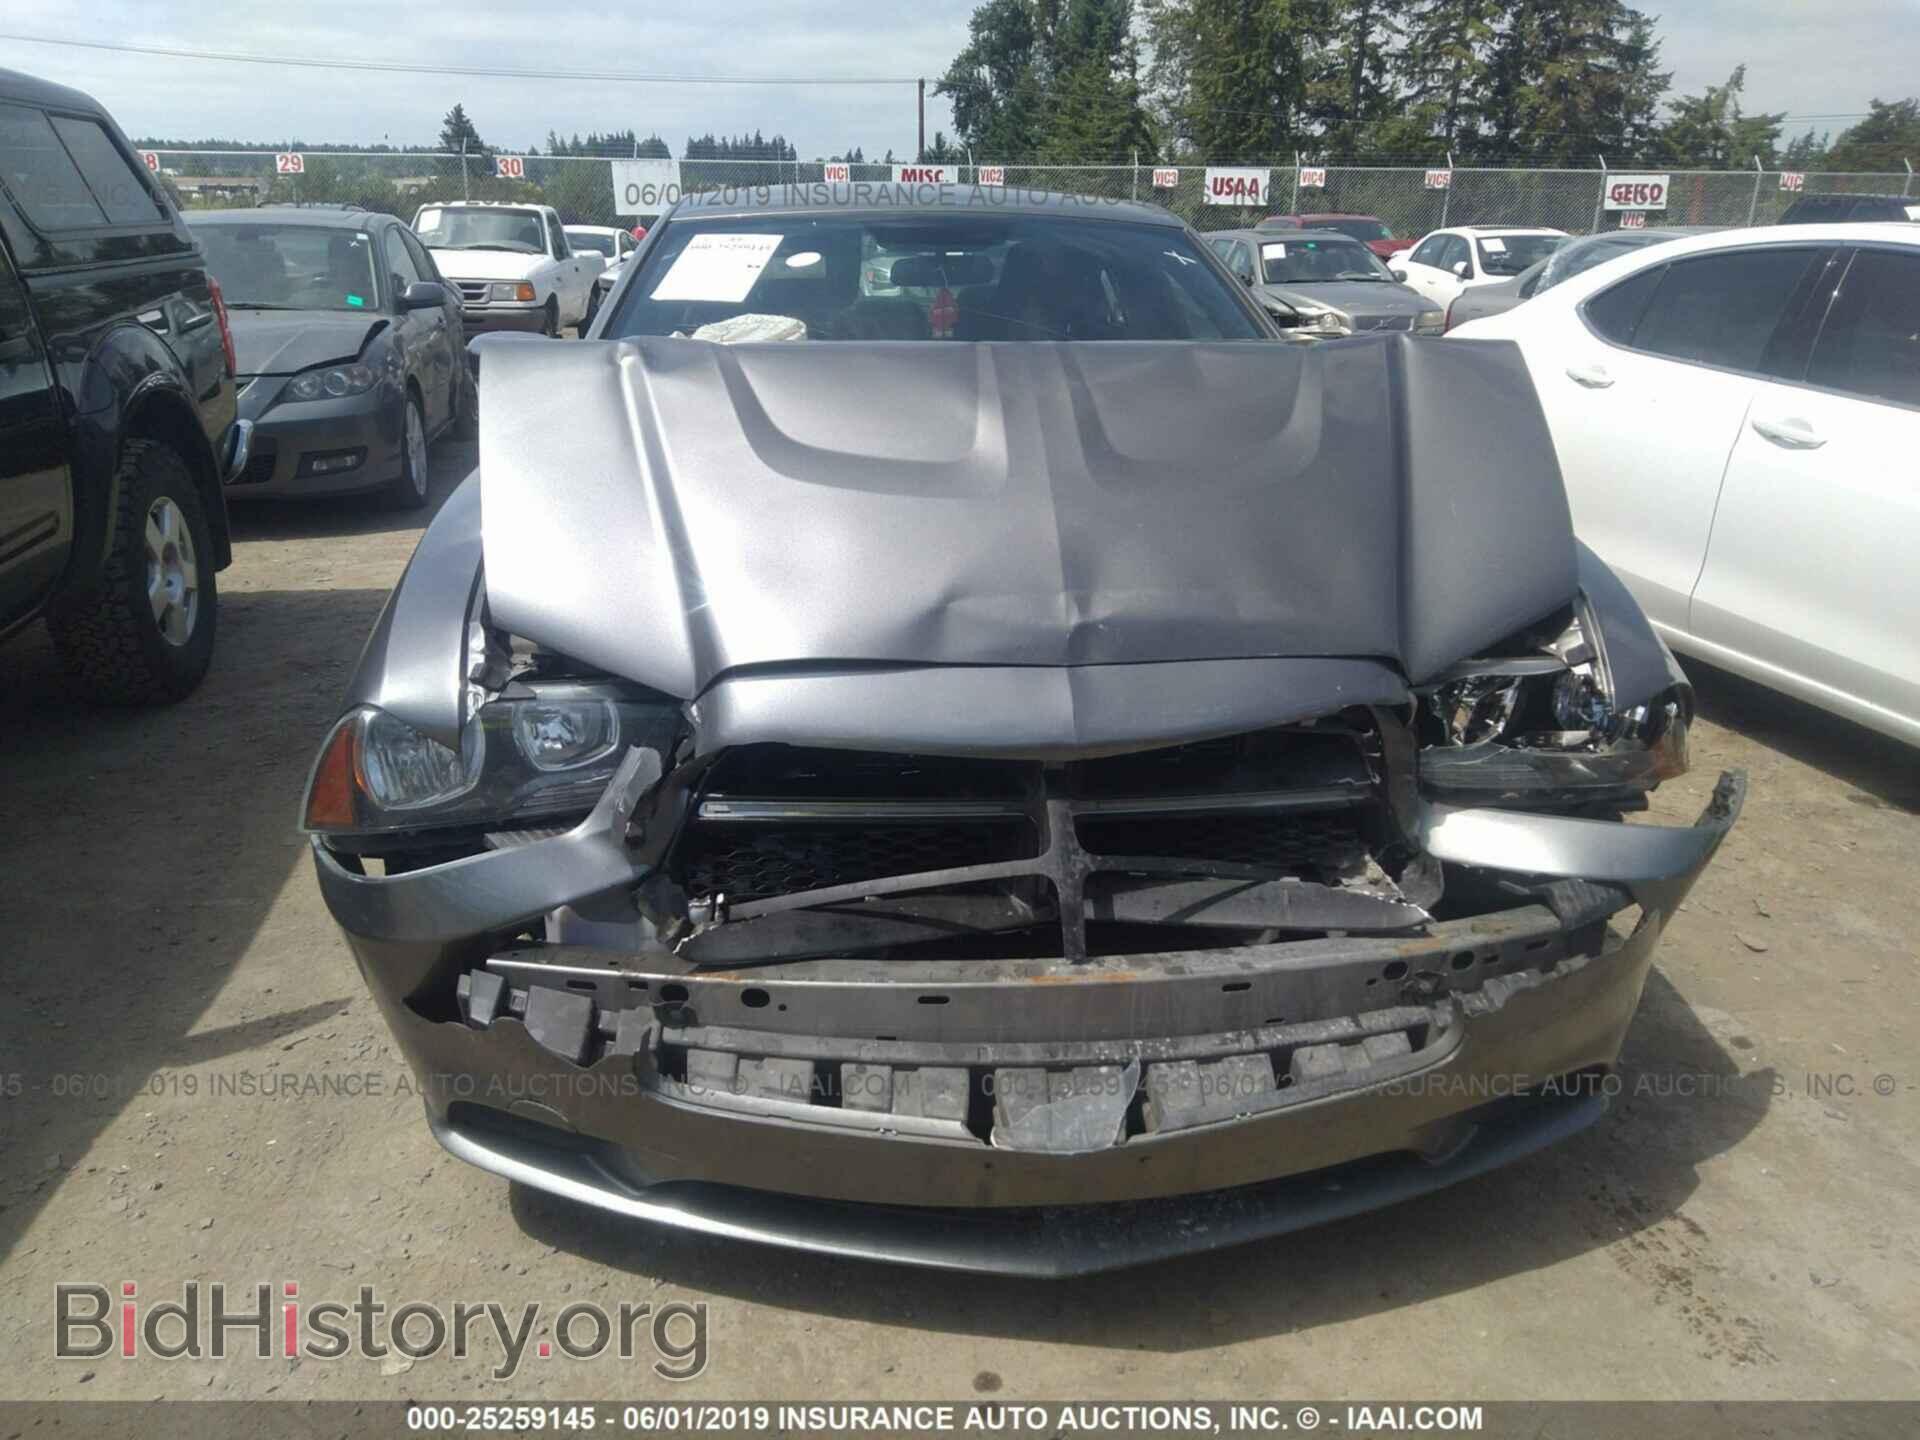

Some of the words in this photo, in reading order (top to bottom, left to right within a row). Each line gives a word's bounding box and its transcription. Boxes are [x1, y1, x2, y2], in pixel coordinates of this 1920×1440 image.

[279, 155, 301, 172] 29
[499, 158, 521, 176] 30
[980, 169, 1003, 183] VIC2
[1154, 171, 1177, 185] VIC3
[1302, 171, 1324, 184] VIC4
[1212, 177, 1260, 197] USAA
